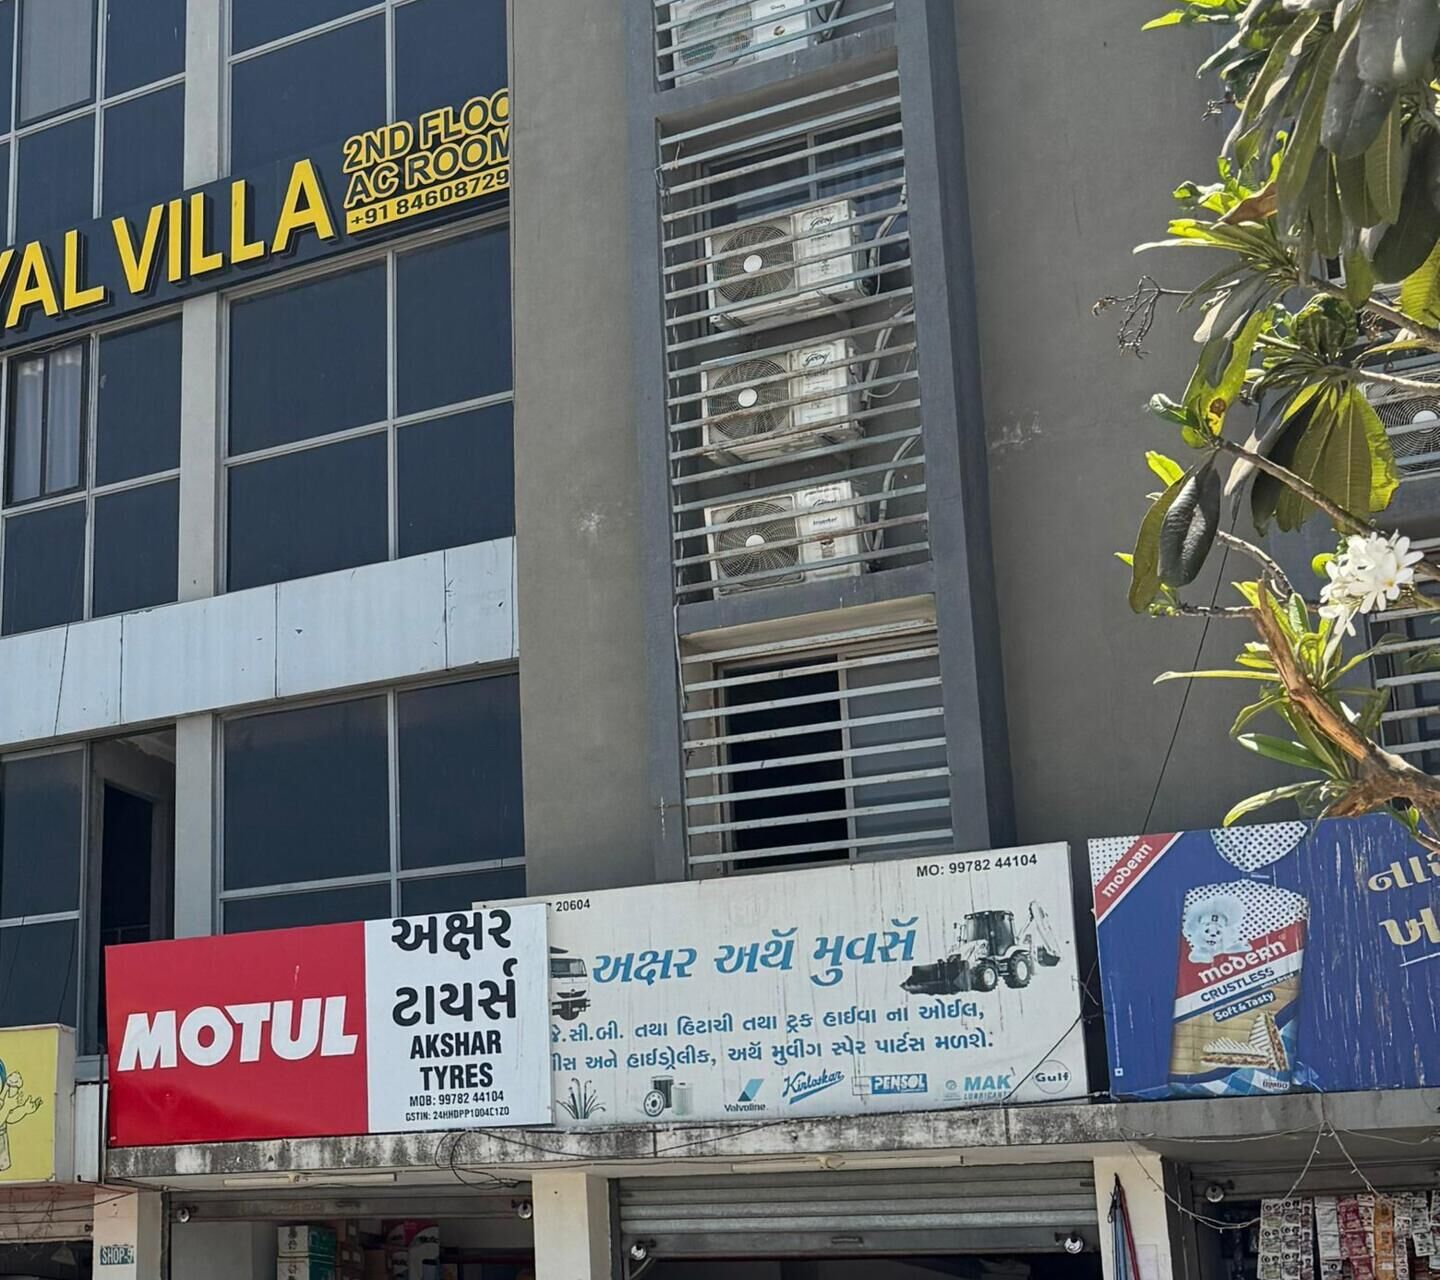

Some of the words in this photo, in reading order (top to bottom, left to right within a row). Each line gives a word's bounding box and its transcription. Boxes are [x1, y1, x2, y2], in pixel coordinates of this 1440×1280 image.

[345, 123, 411, 170] 2ND
[347, 165, 398, 206] AC
[351, 204, 388, 225] +91
[396, 169, 509, 216] 84608729
[112, 160, 333, 295] VILLA
[916, 864, 945, 878] MO:
[949, 859, 990, 874] 99782
[995, 854, 1038, 869] 44104
[556, 898, 591, 912] 20604
[391, 908, 512, 960] અક્ષર
[592, 948, 697, 986] અક્ષર
[392, 957, 518, 1026] ટાયર્સ
[1200, 967, 1275, 1003] CRUSTLESS
[117, 995, 359, 1072] MOTUL
[635, 1023, 667, 1038] તથા
[743, 1015, 777, 1031] તથા
[409, 1029, 502, 1060] AKSHAR
[420, 1062, 493, 1091] TYRES
[964, 1074, 1011, 1091] MAK
[1035, 1071, 1069, 1084] Gulf
[409, 1095, 436, 1107] MOB:
[439, 1093, 469, 1106] 99782
[473, 1090, 504, 1103] 44104
[724, 1102, 766, 1113] Valvoline
[406, 1111, 431, 1122] GSTIN:
